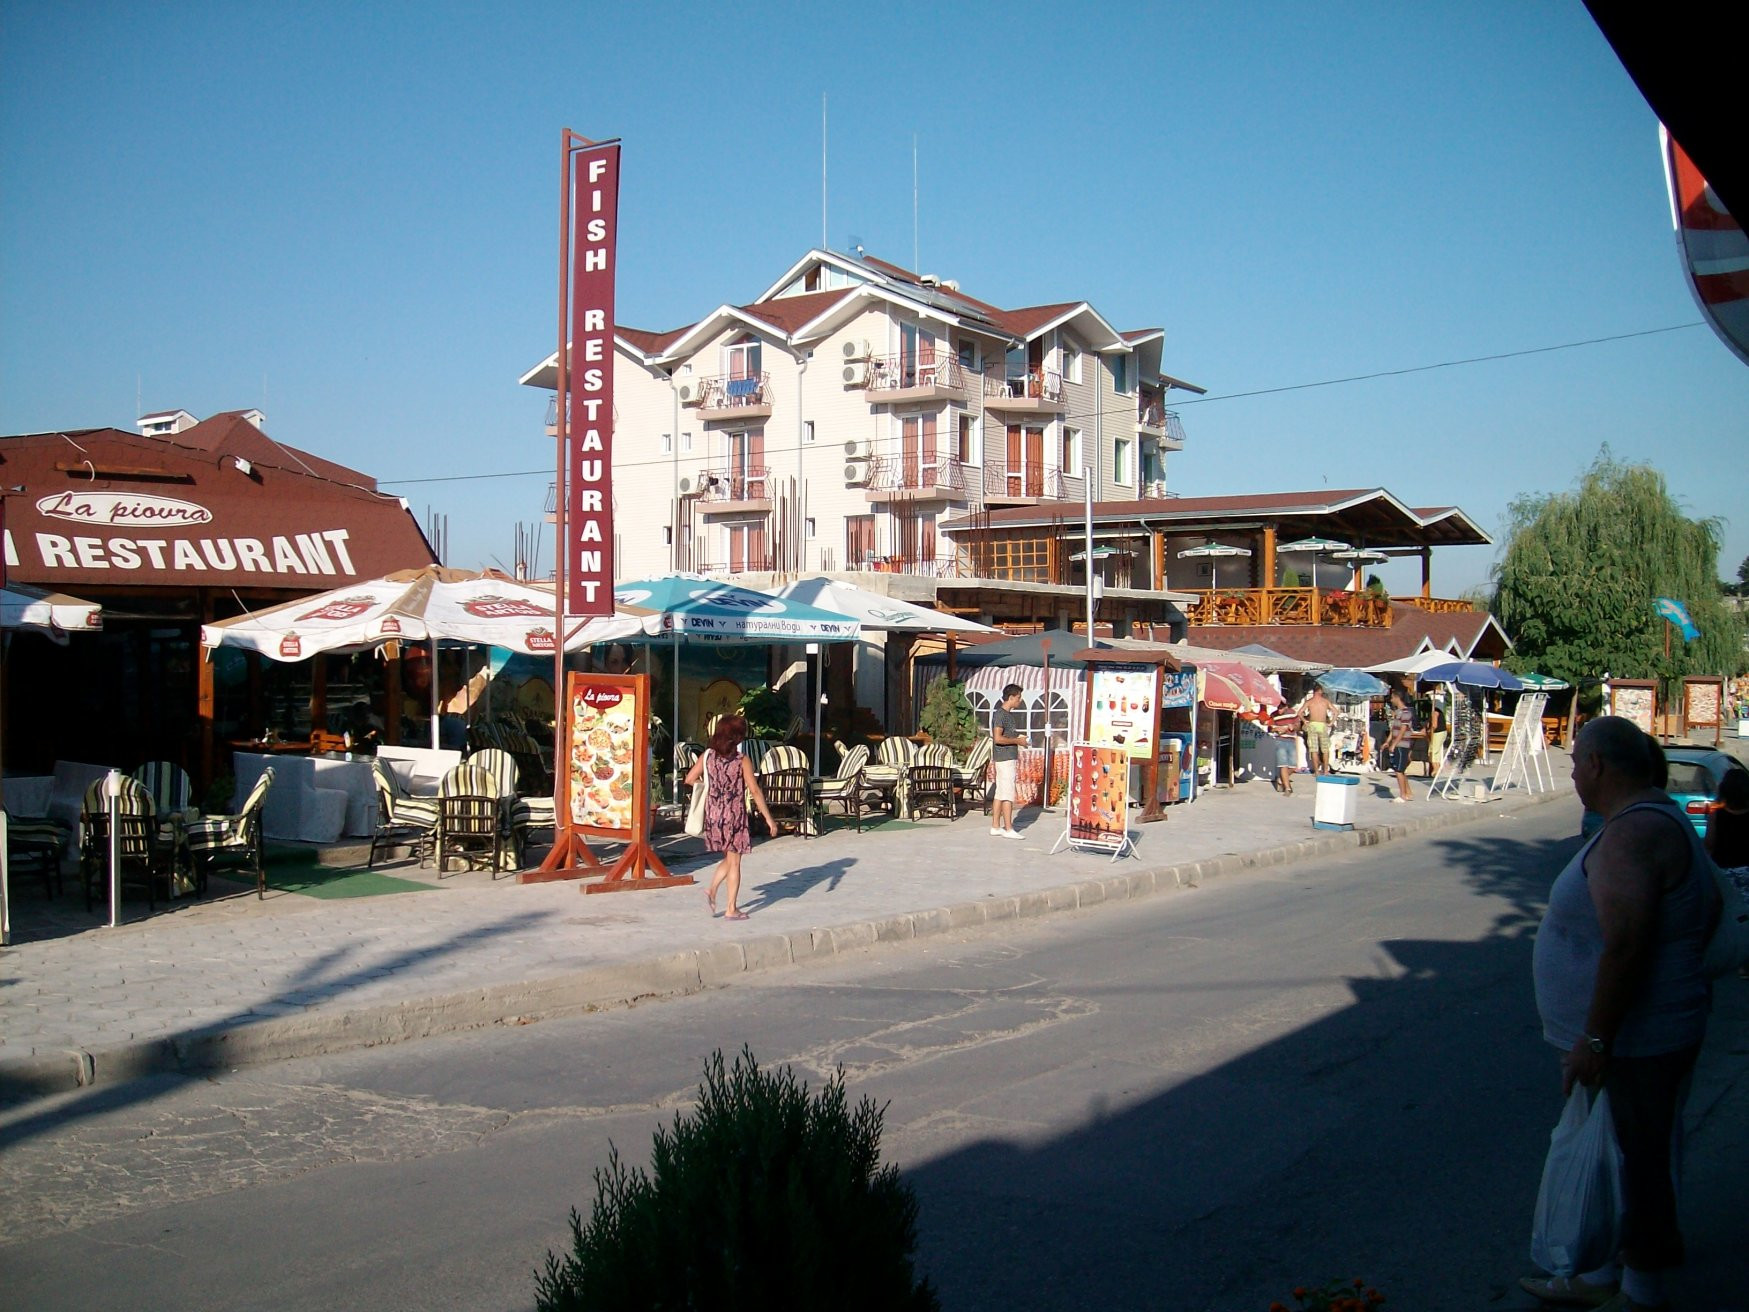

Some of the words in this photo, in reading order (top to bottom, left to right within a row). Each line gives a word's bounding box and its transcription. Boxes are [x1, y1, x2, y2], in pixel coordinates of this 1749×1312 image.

[585, 159, 607, 273] FISH
[580, 308, 606, 603] RESTAURANT
[44, 492, 96, 517] La
[35, 528, 357, 576] RESTAURANT
[690, 616, 715, 628] DEVIN
[736, 619, 780, 632] натурални
[820, 623, 840, 633] DEVIN
[584, 688, 595, 701] La
